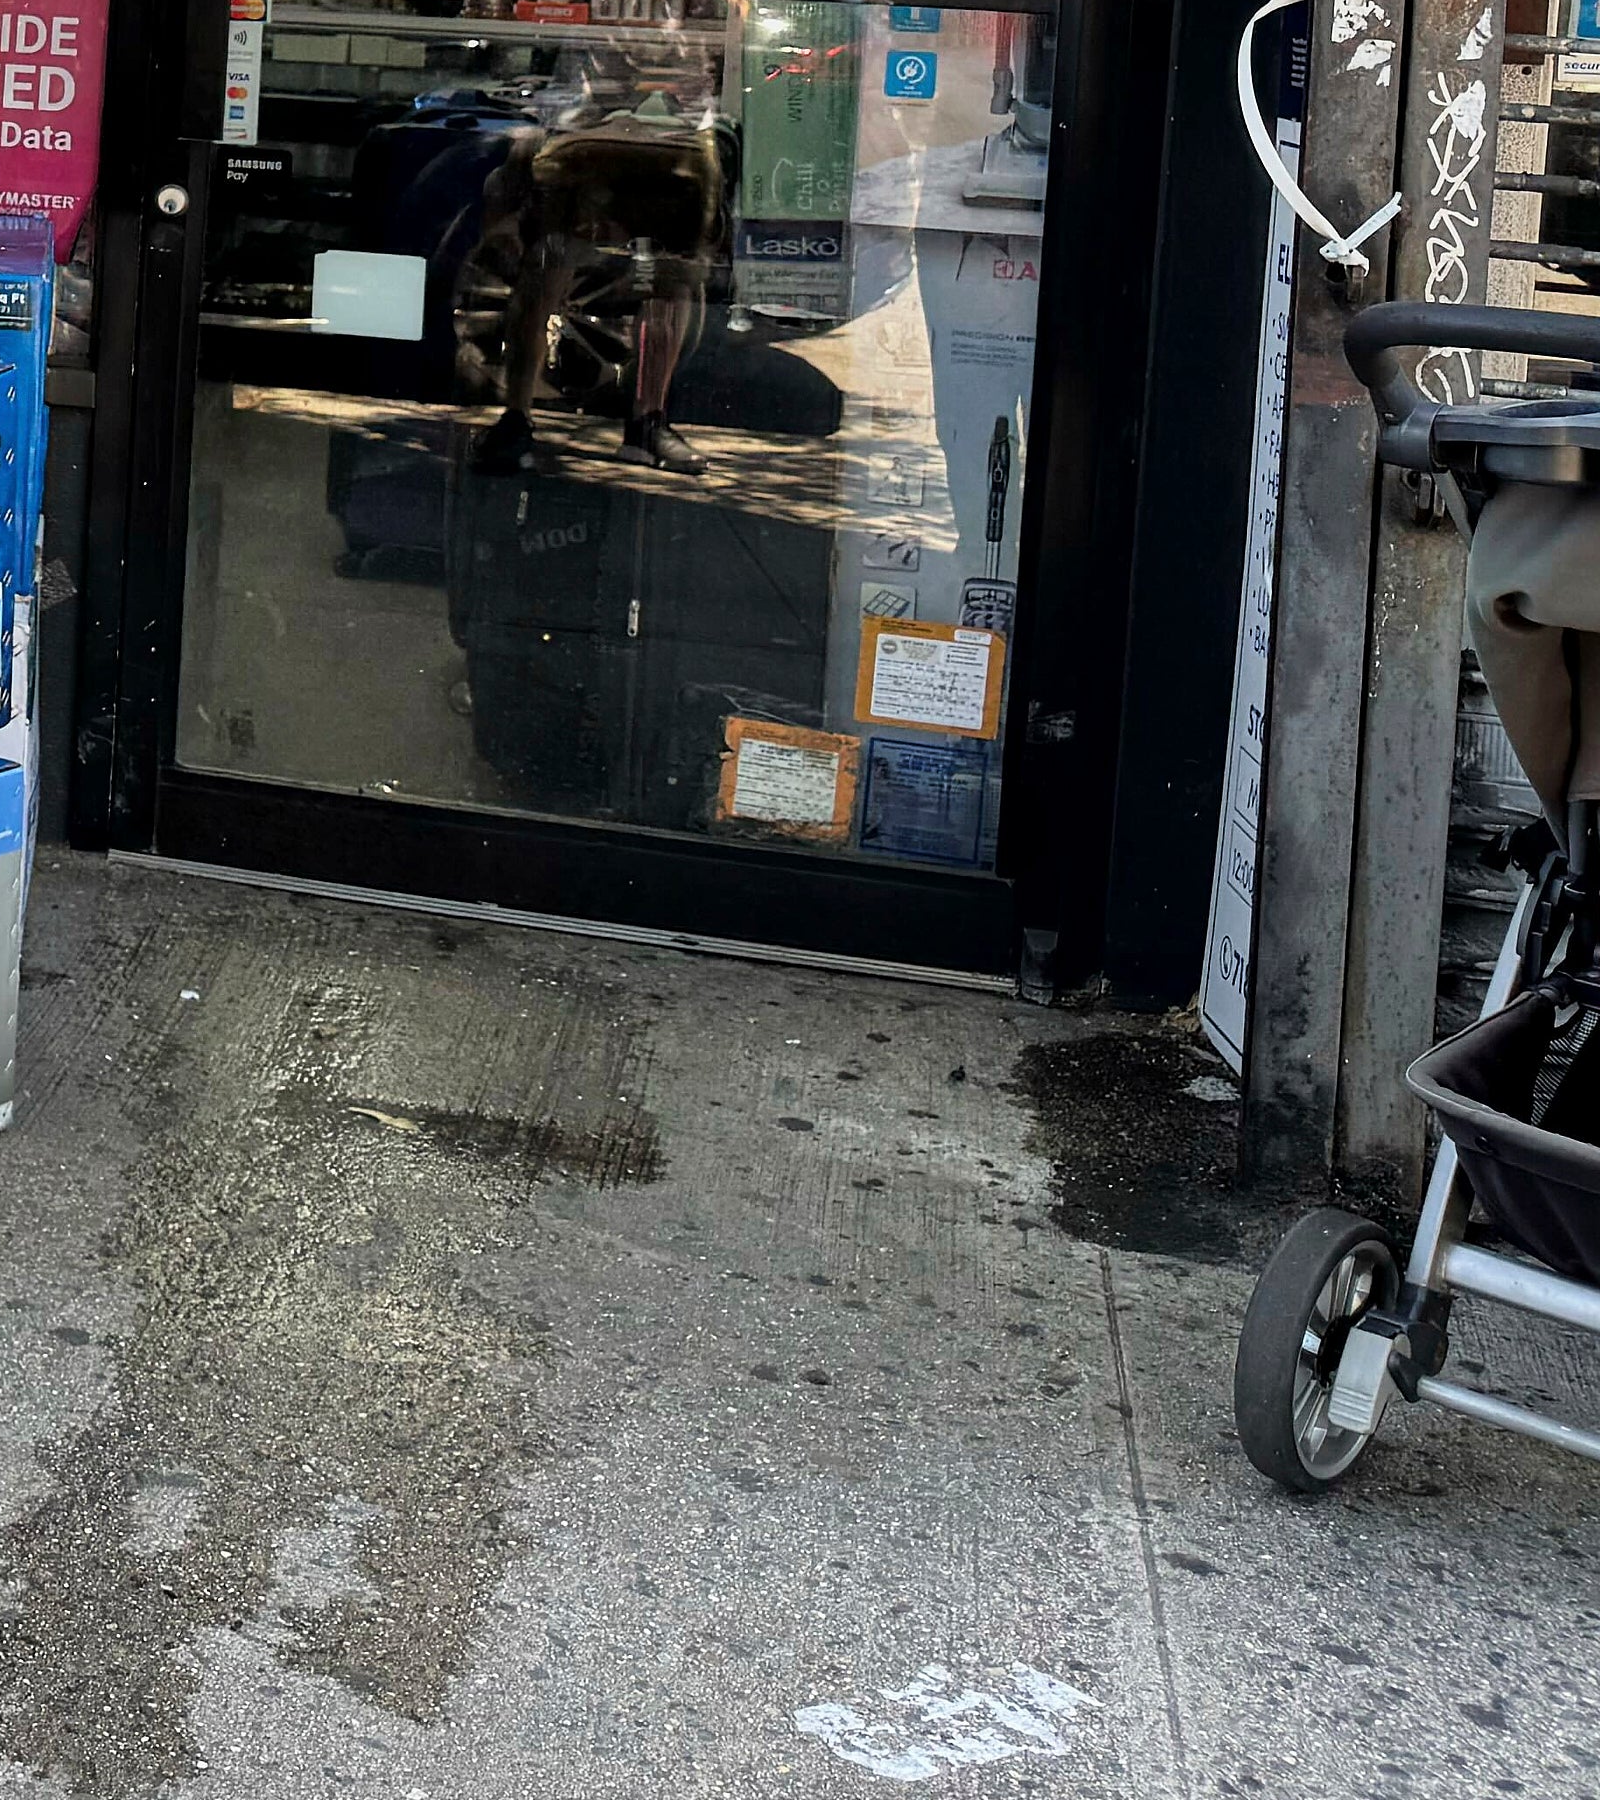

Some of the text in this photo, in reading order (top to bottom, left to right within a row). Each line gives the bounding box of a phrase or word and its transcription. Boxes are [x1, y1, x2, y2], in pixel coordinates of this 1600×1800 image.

[0, 120, 73, 151] Data
[227, 157, 283, 170] SAMSUNG
[745, 233, 840, 256] Lasko
